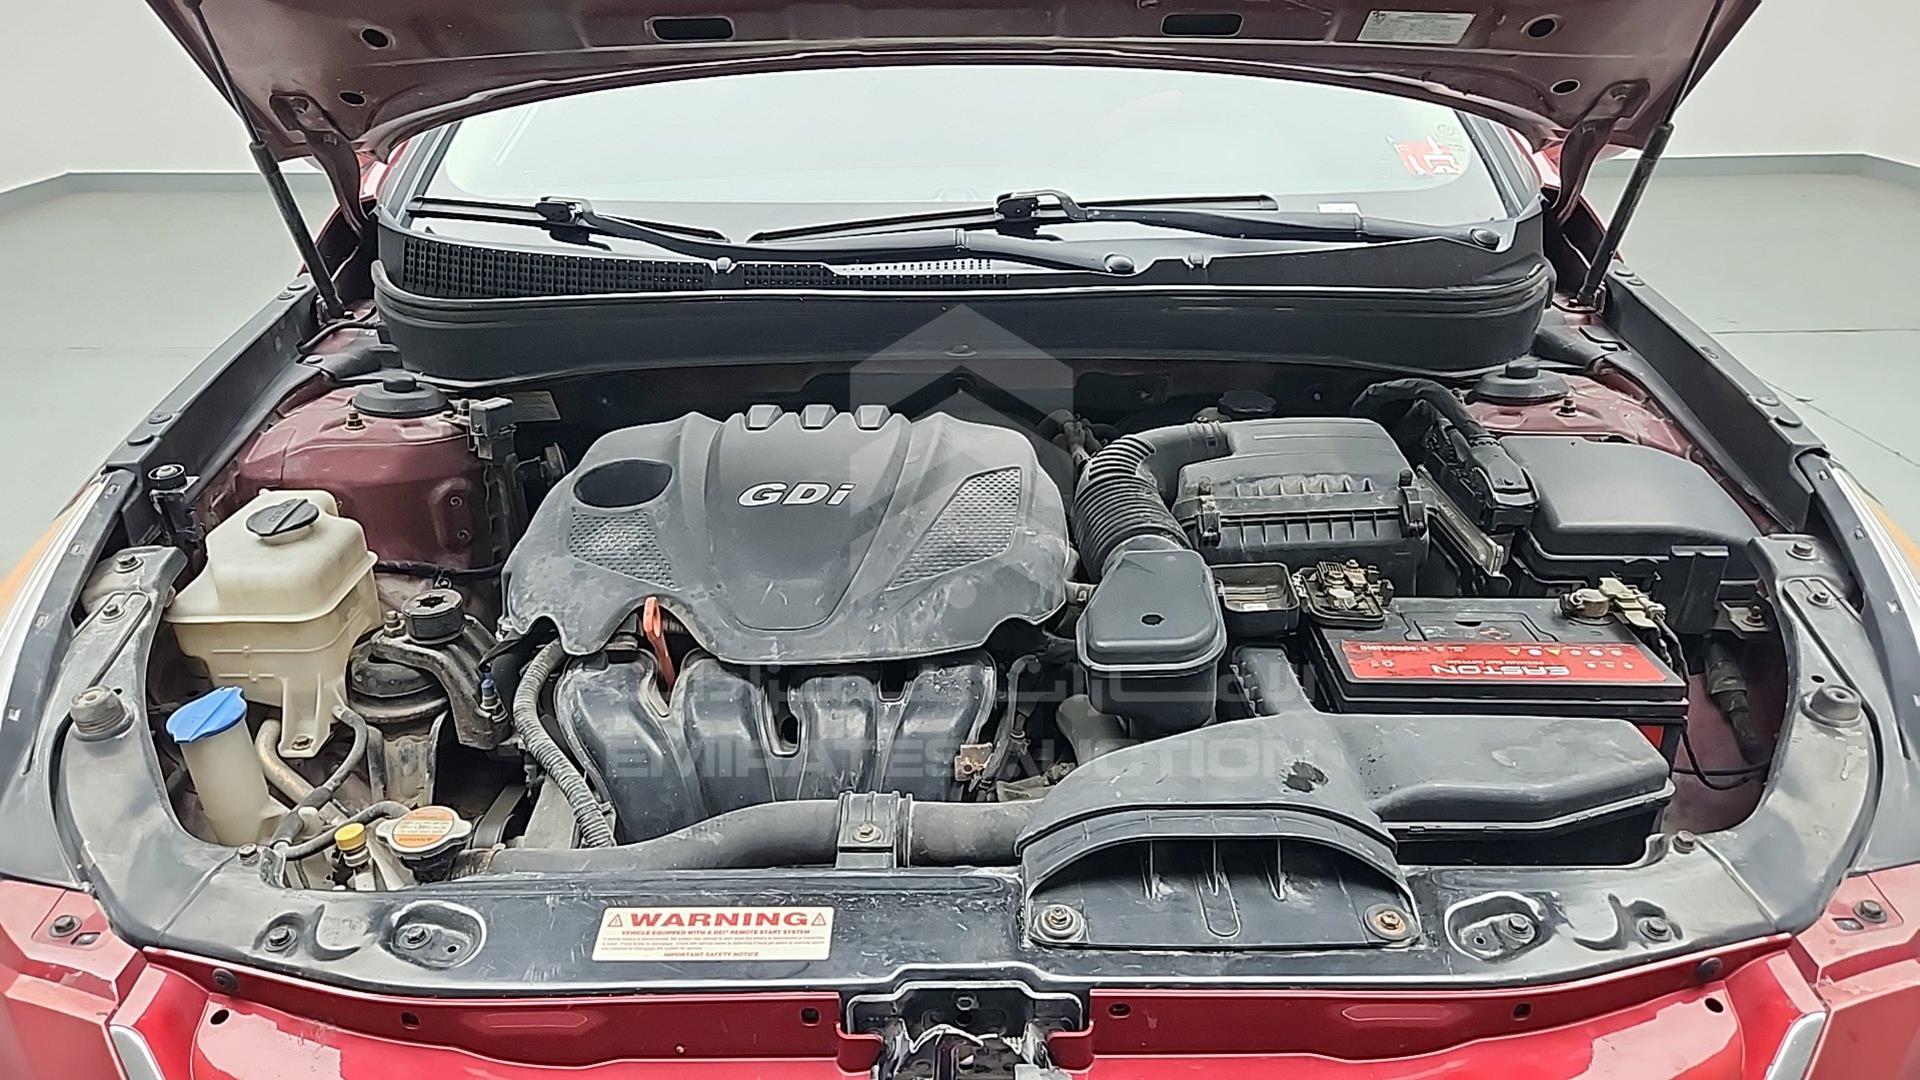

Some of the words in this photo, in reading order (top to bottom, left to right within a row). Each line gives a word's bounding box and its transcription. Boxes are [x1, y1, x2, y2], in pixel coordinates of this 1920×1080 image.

[737, 482, 856, 507] GDi
[1431, 664, 1570, 676] EASTON
[630, 912, 808, 927] WARNING
